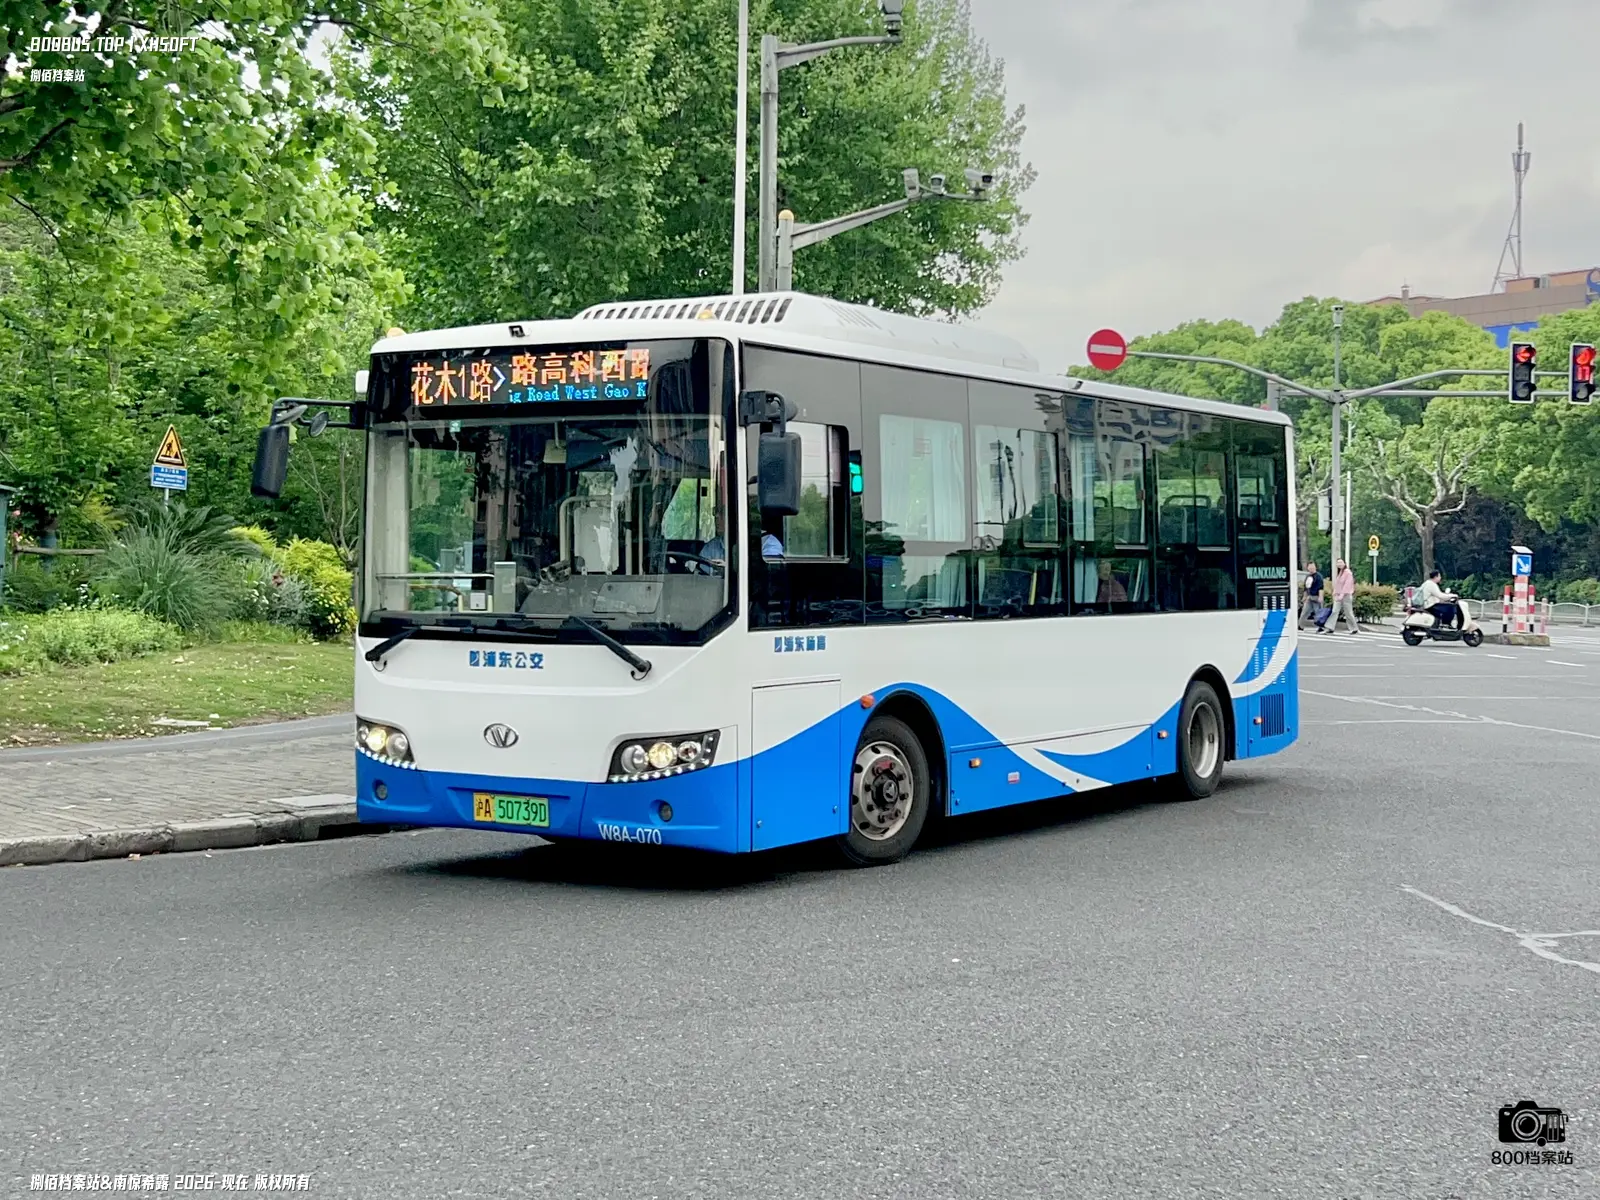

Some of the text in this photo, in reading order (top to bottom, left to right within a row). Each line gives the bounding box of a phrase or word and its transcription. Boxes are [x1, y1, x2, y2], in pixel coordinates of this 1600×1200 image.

[411, 359, 493, 406] 花木1路
[527, 384, 559, 402] Road
[565, 385, 597, 400] West
[604, 383, 629, 398] Gao
[1246, 566, 1287, 579] WANXIANG
[483, 650, 544, 669] 浦东公交
[598, 824, 662, 845] W8A-070
